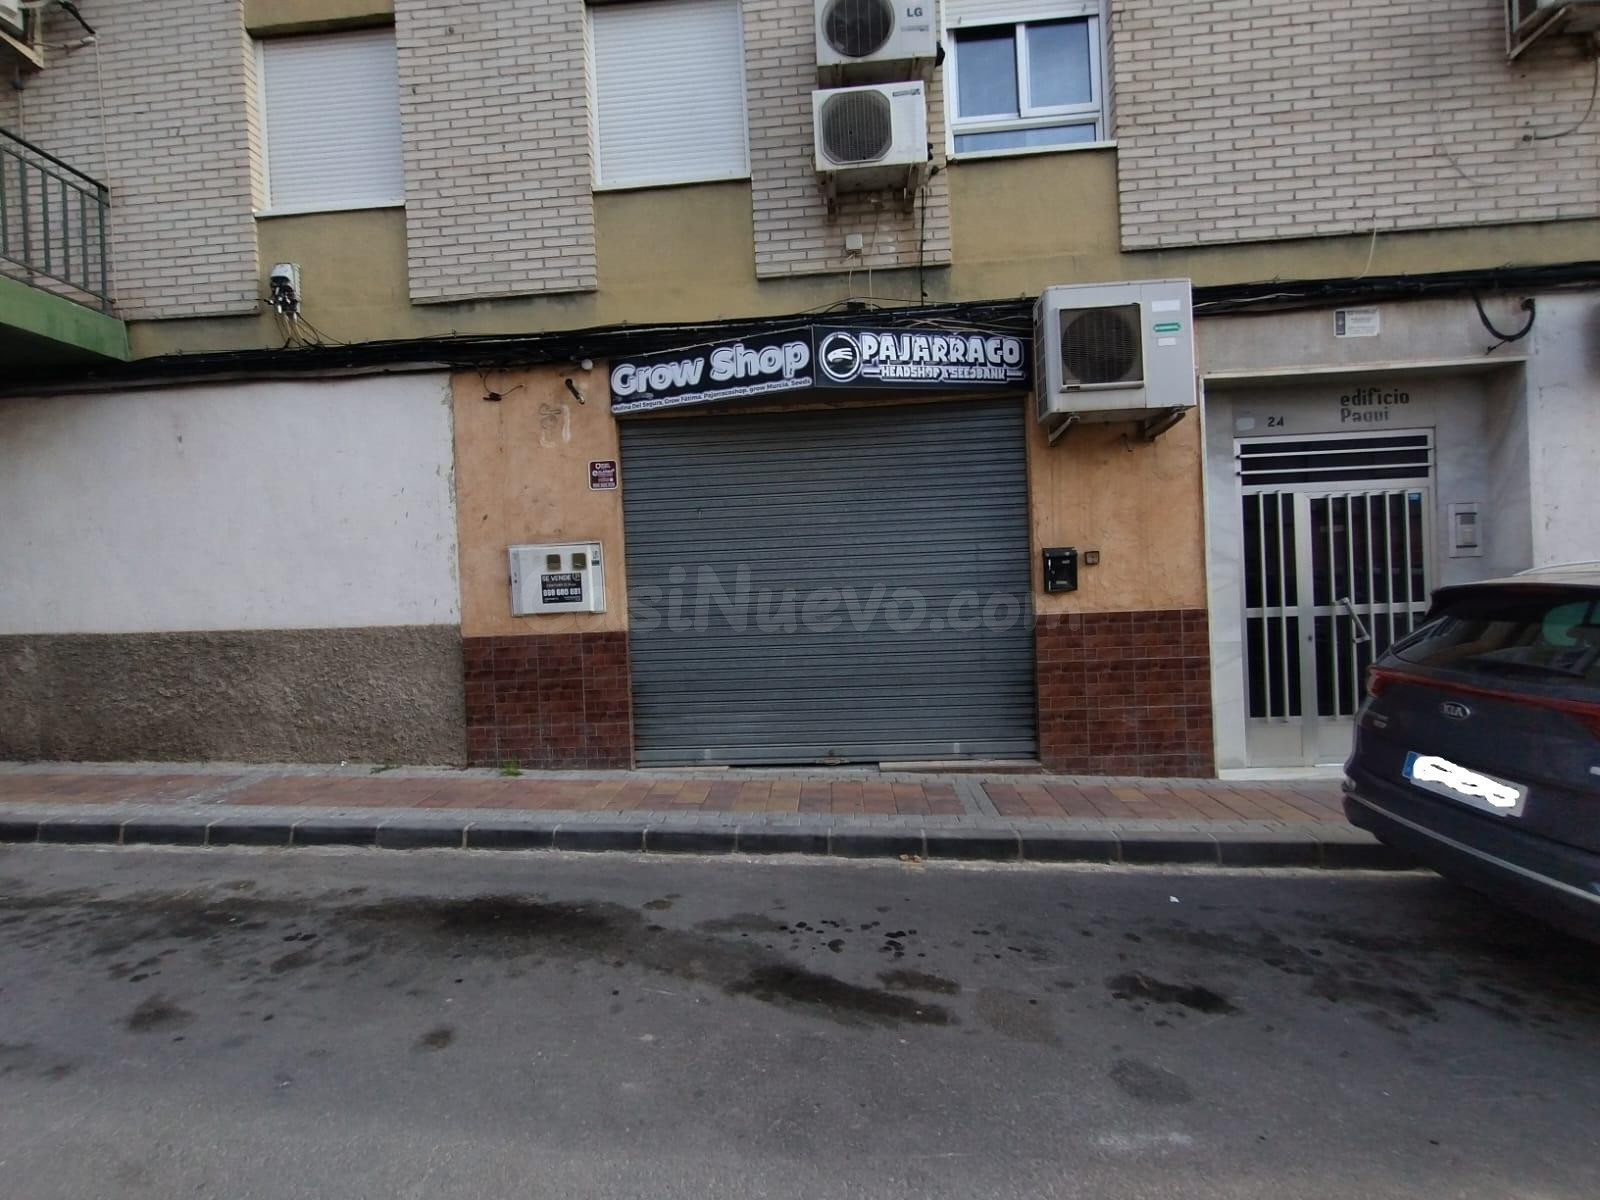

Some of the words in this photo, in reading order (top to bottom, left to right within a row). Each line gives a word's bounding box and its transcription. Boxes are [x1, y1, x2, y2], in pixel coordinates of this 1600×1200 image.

[906, 7, 923, 17] LG
[611, 357, 704, 396] Grow
[709, 341, 810, 381] Shop
[1340, 387, 1410, 407] edificio
[1267, 416, 1285, 427] 24
[1442, 703, 1464, 717] KIA
